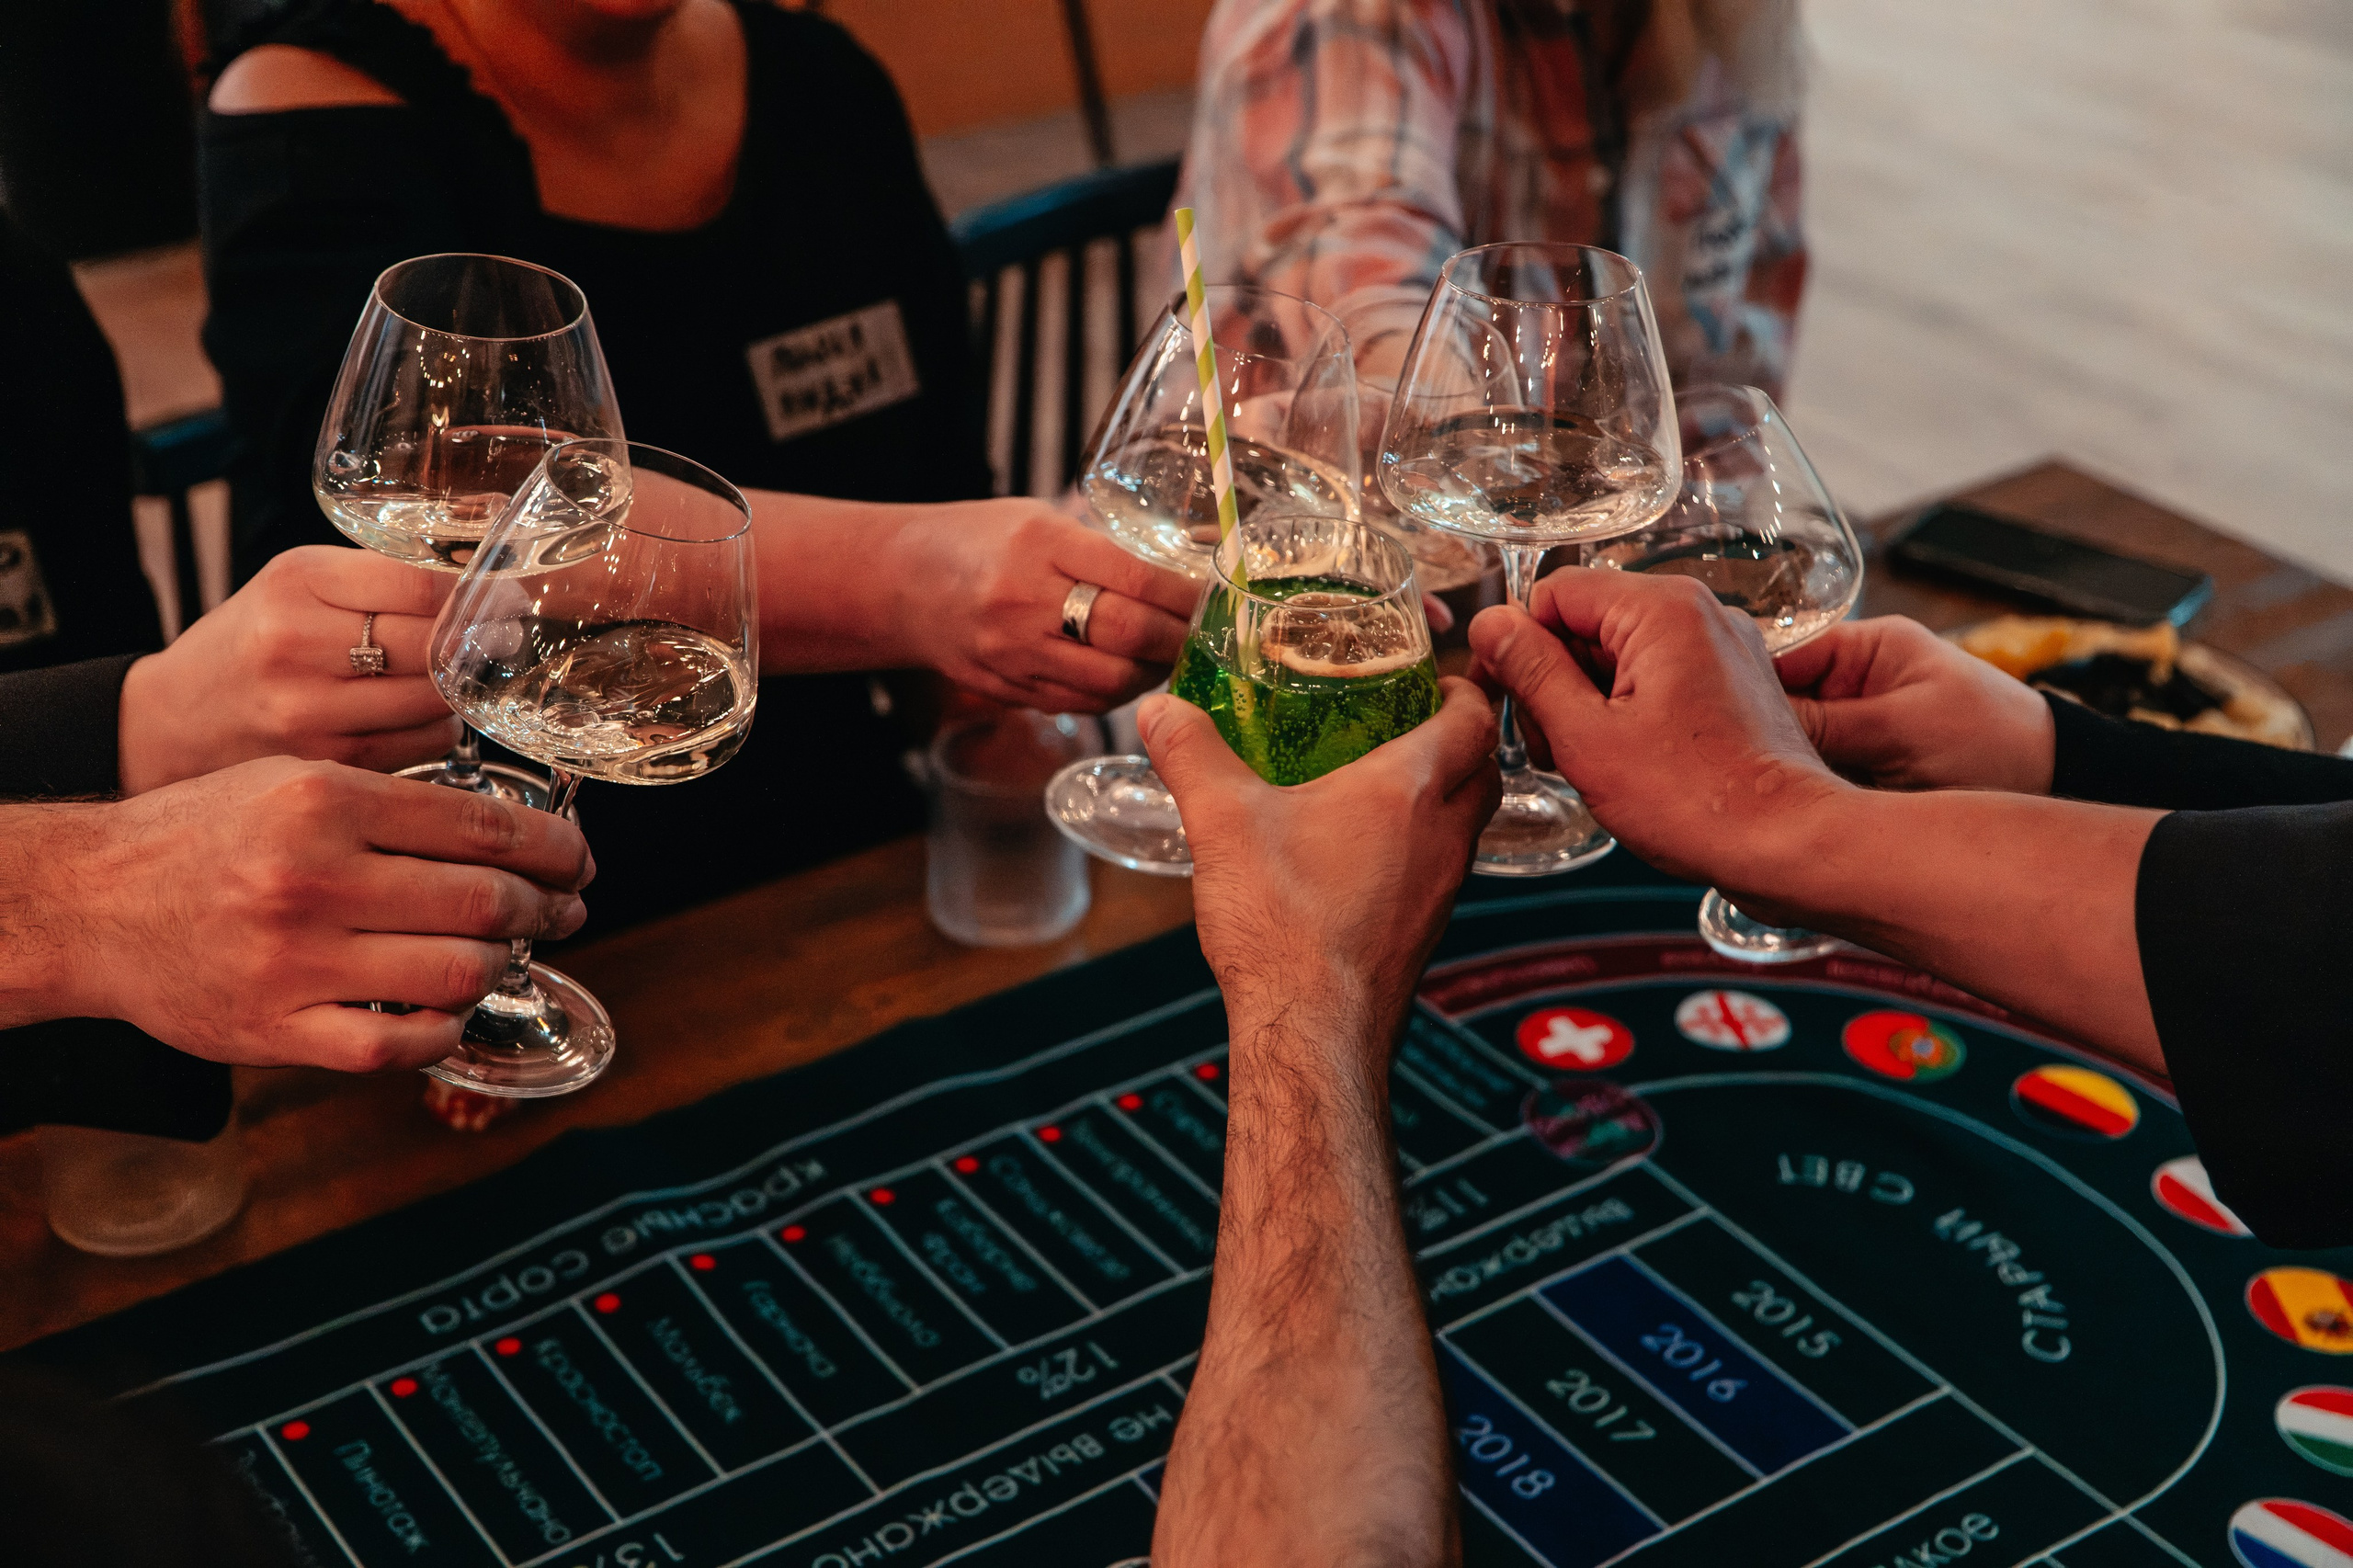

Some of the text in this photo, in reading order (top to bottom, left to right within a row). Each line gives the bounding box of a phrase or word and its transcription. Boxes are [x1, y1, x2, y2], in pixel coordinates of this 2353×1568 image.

[419, 1158, 824, 1336] красные сорта
[1428, 1198, 1635, 1302] выдержан
[1777, 1152, 2072, 1363] СТАРЫЙ СВЕТ
[1731, 1278, 1843, 1359] 2015
[1016, 1340, 1120, 1402] 12%
[1639, 1322, 1748, 1403] 2016
[1108, 1403, 1174, 1443] не
[1545, 1369, 1657, 1441] 2017
[333, 1437, 432, 1554] Пинотаж
[1459, 1414, 1556, 1500] 2018
